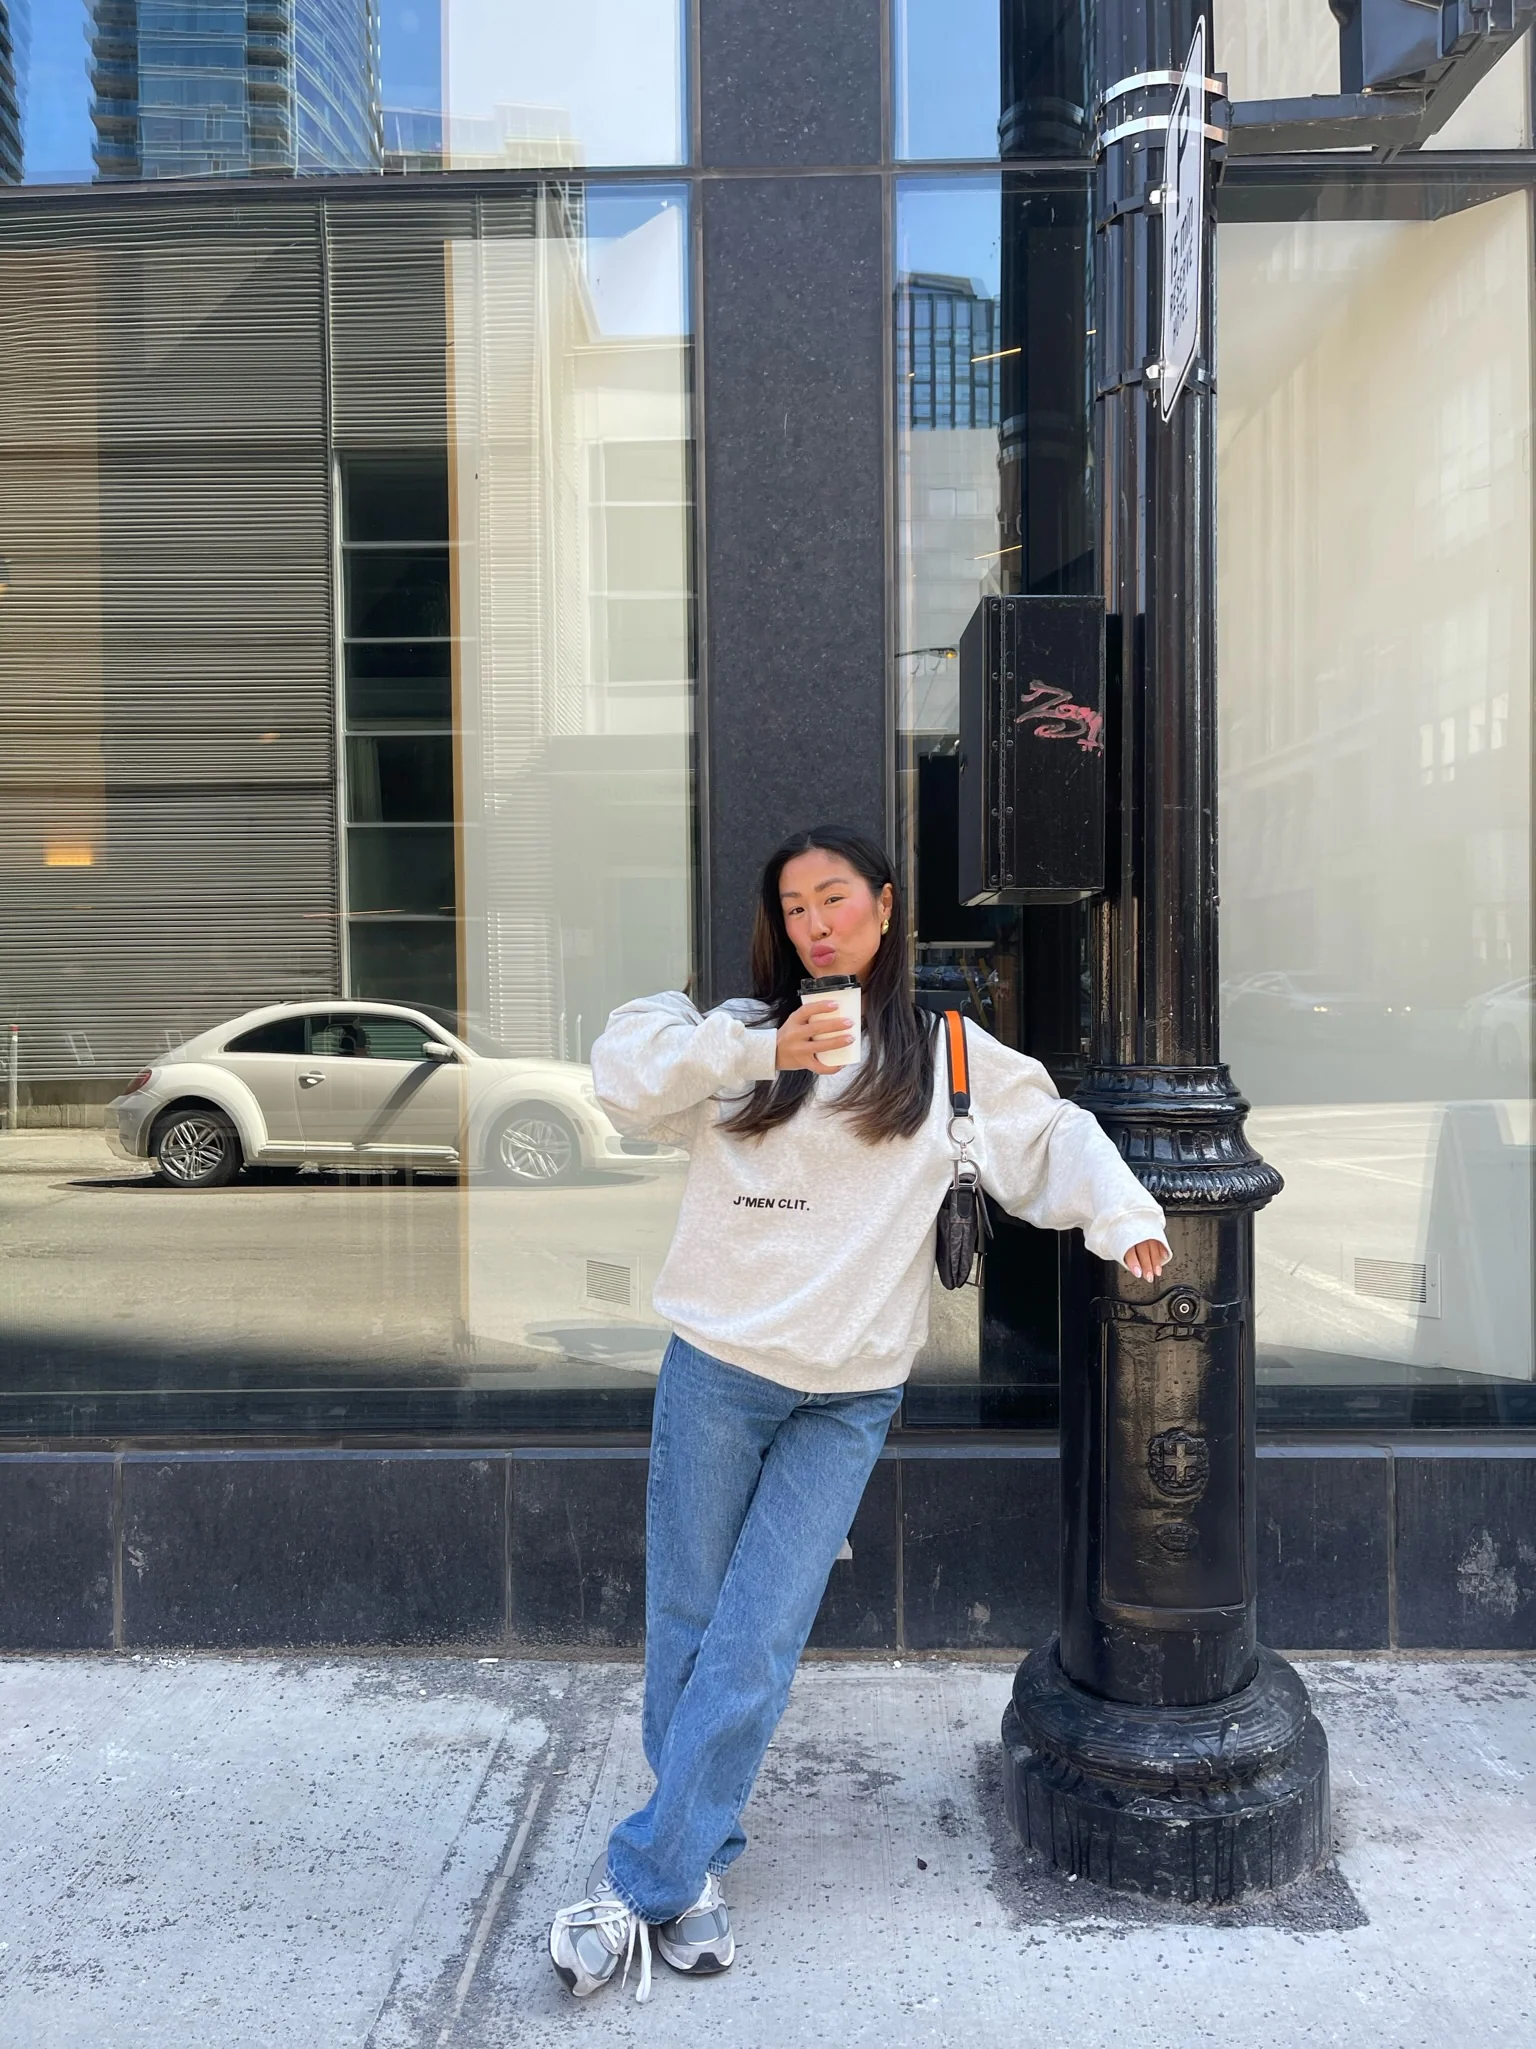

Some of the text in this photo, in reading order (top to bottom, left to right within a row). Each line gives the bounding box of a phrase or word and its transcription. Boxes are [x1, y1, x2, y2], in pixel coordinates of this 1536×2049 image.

[1170, 196, 1194, 285] 15 min
[733, 1195, 810, 1211] J'MEN CLIT.
